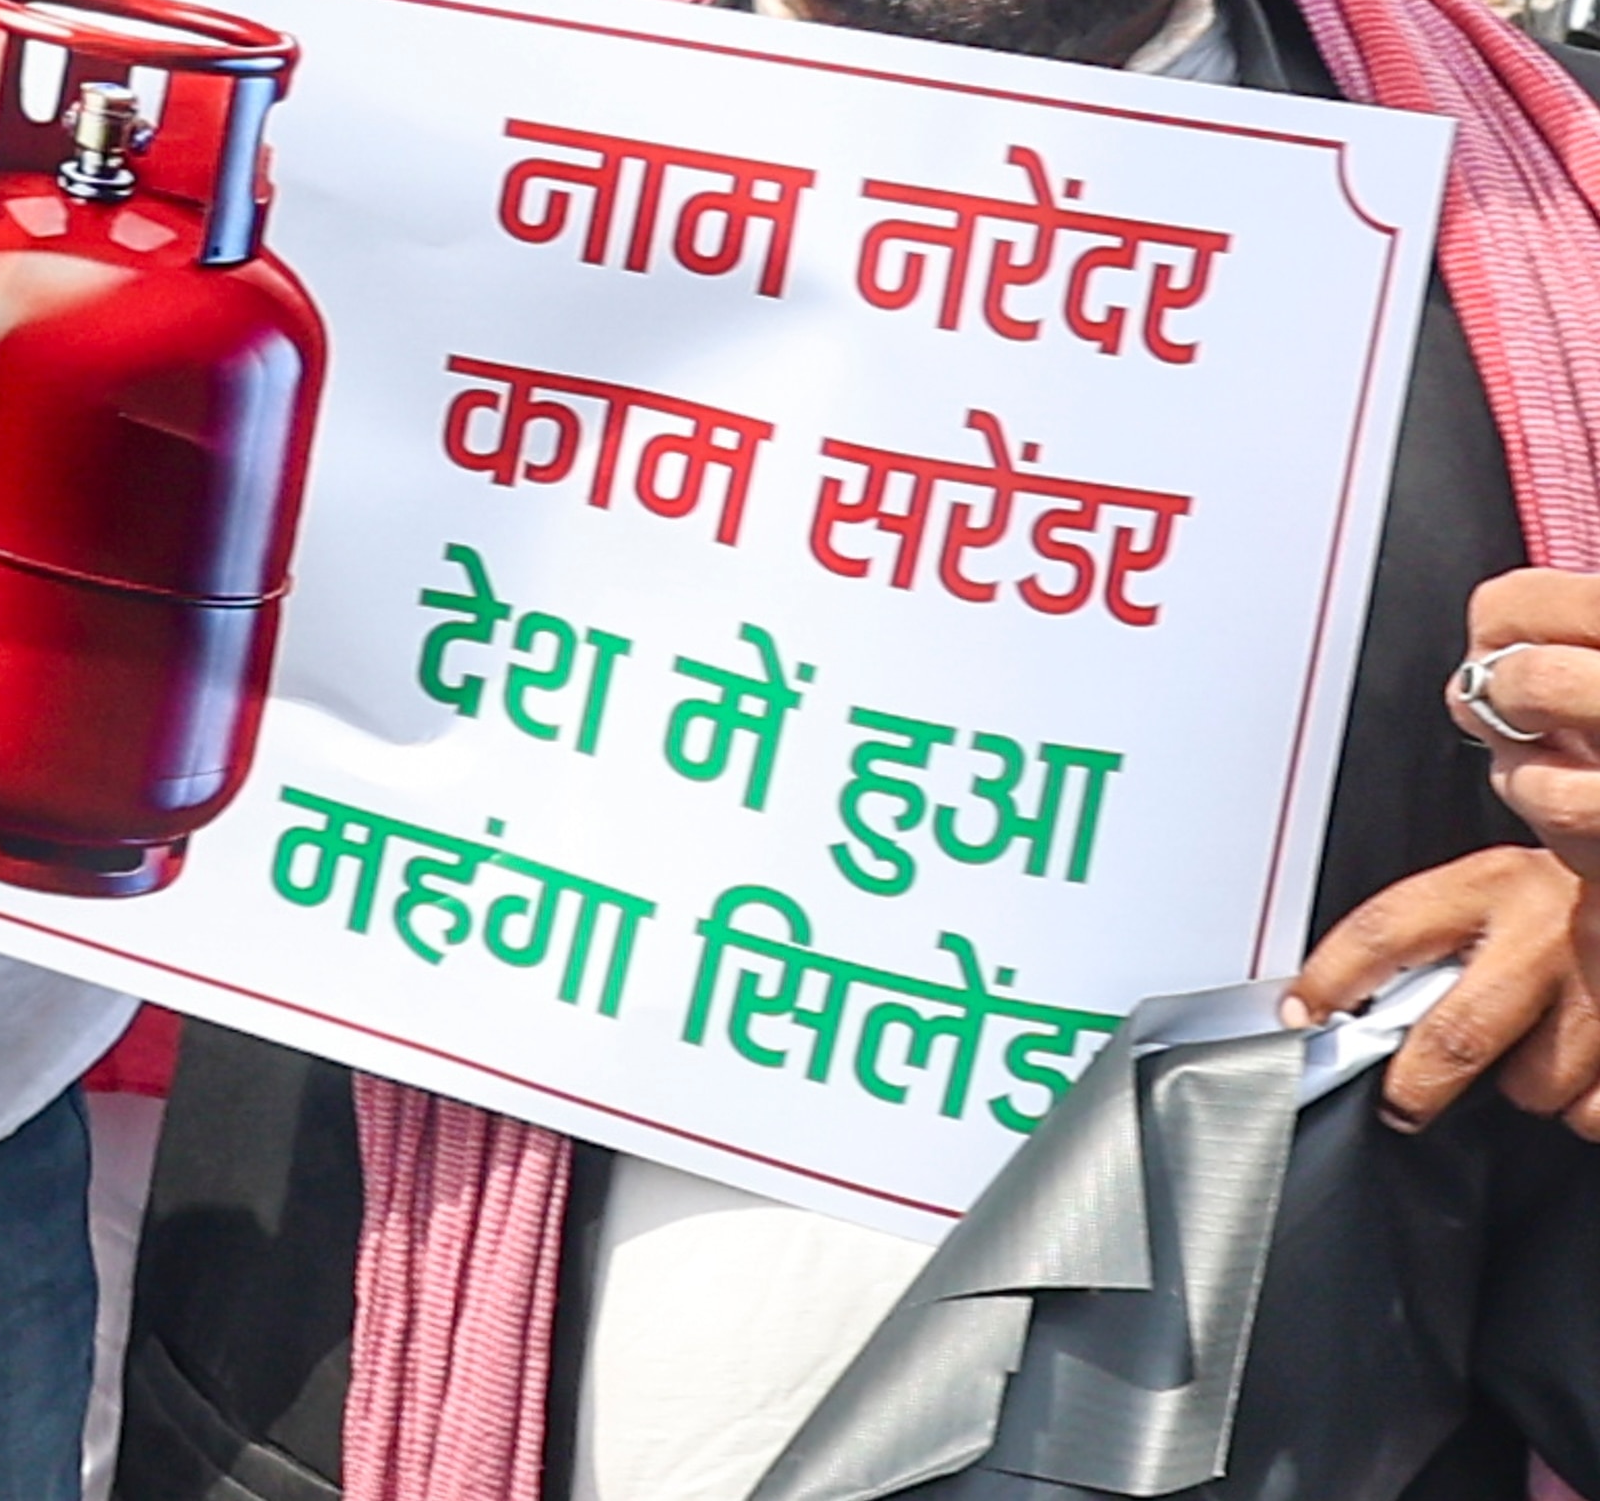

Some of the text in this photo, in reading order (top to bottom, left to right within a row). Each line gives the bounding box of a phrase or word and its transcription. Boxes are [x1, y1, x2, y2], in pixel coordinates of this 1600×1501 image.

[498, 117, 1231, 366] नाम नरेंदर
[443, 354, 1193, 628] काम सरेंडर
[417, 542, 1125, 898] देश में हुआ
[270, 784, 1127, 1136] महंगा सिलेंड
